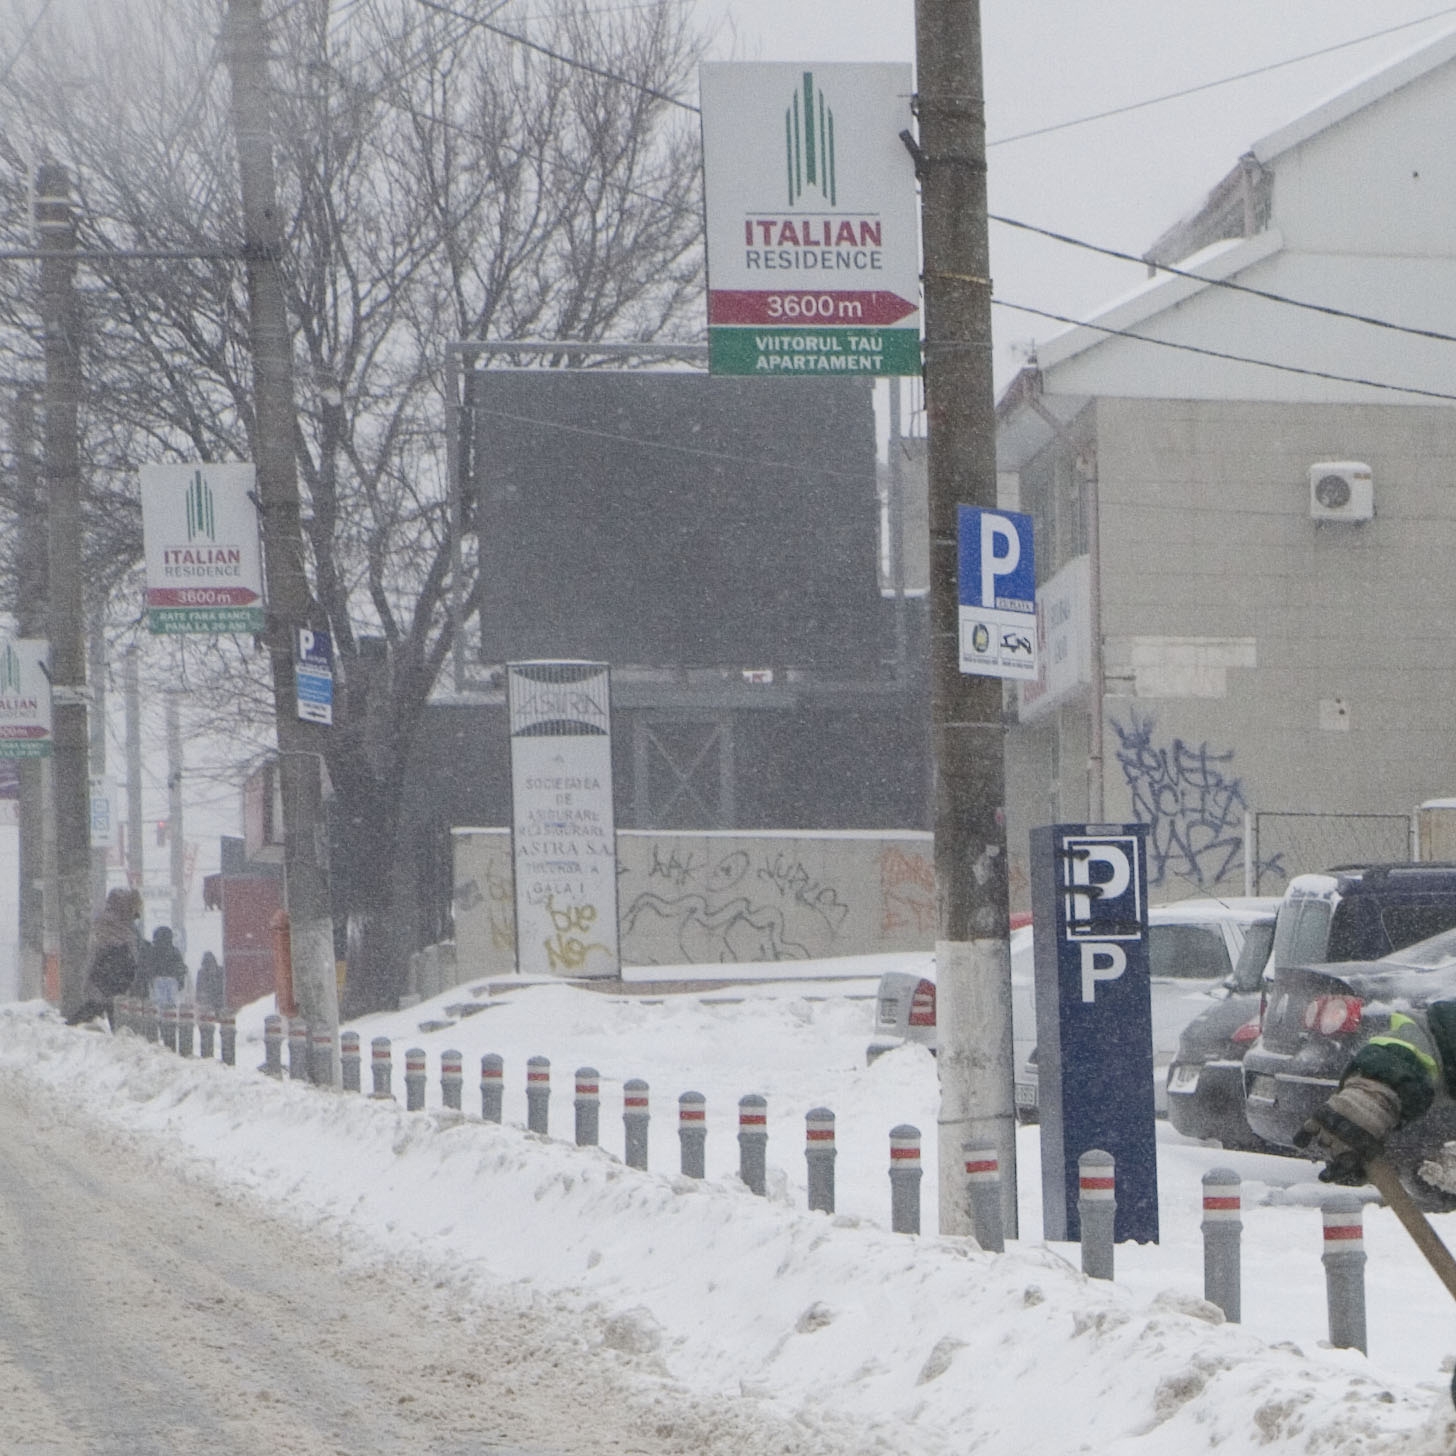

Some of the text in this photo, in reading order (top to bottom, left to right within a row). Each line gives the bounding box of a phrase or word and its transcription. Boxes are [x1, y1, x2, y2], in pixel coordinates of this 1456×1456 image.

[745, 220, 882, 247] ITALIAN
[746, 250, 883, 270] RESIDENCE
[767, 296, 863, 318] 3600 m
[755, 337, 883, 351] VIITORUL TAU
[755, 355, 884, 370] APARTAMENT
[163, 549, 241, 564] ITALIAN
[980, 512, 1020, 608] P
[165, 566, 241, 577] RESIDENCE
[1080, 943, 1127, 1002] P
